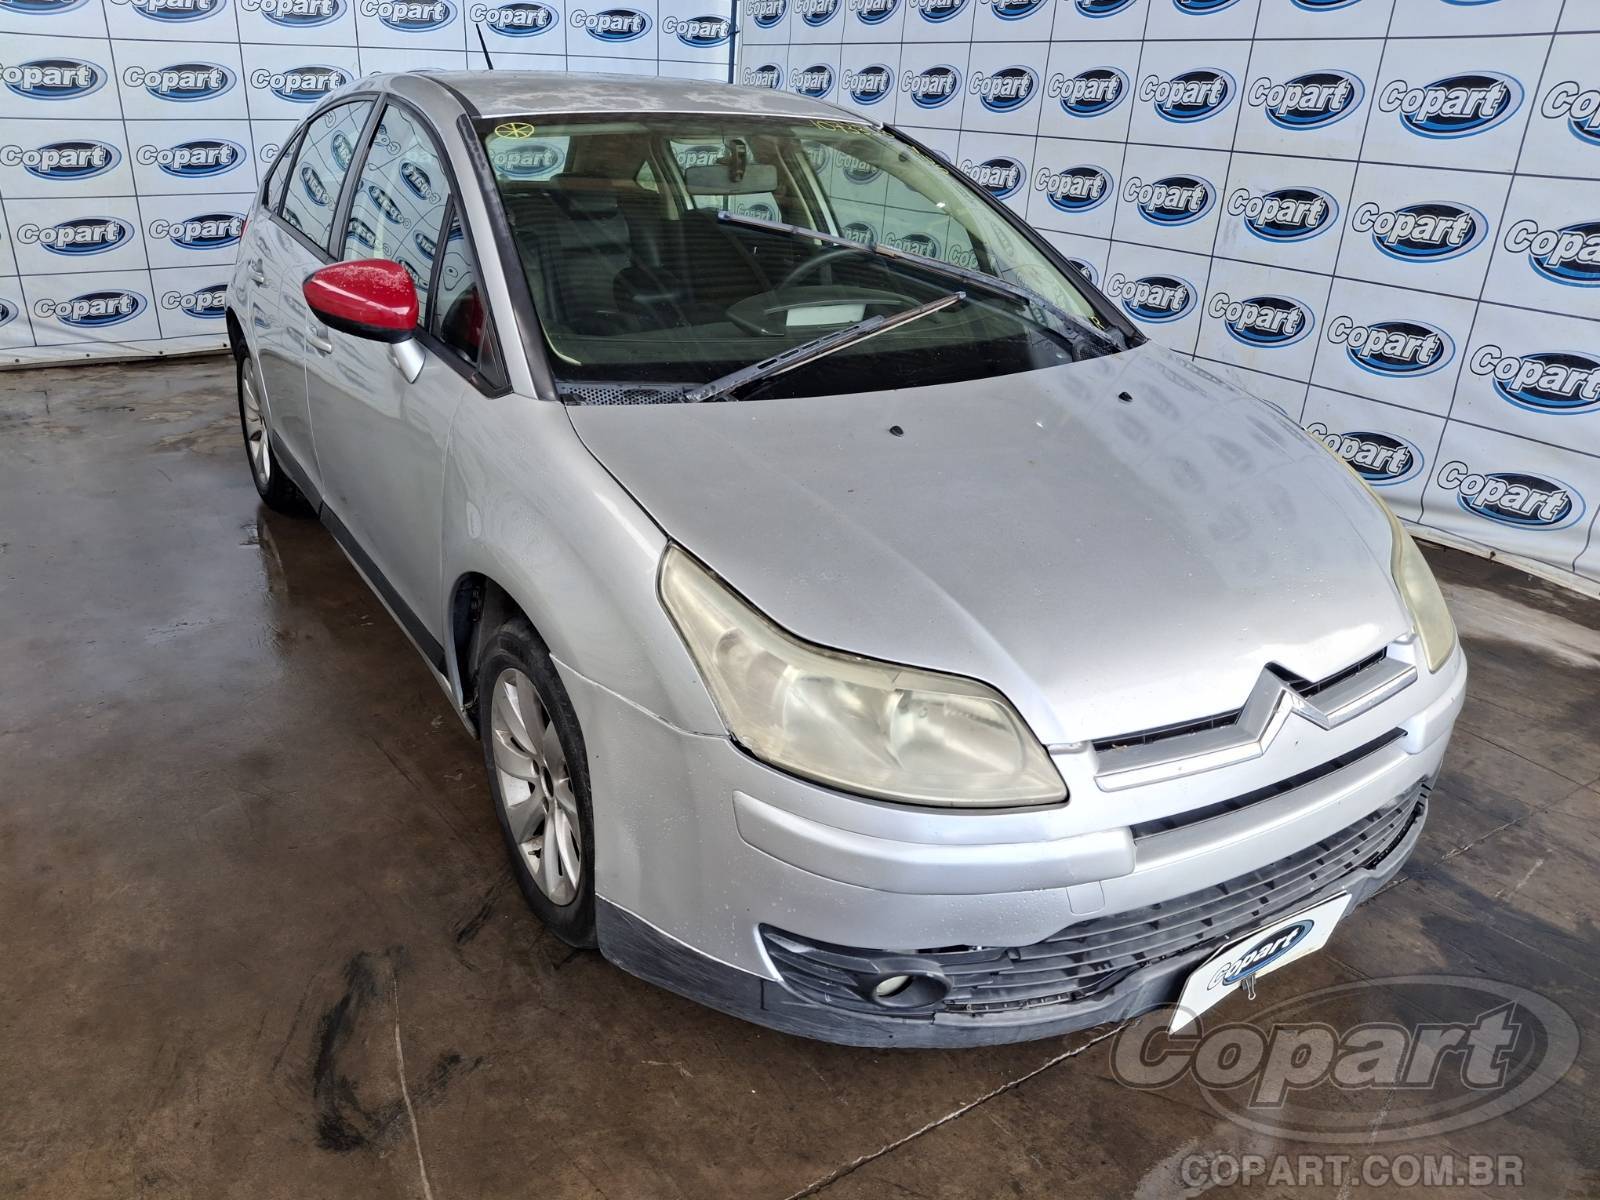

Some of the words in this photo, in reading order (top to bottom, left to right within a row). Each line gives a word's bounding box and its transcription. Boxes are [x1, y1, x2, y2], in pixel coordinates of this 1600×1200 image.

[360, 0, 445, 21] Copart
[470, 4, 549, 28] Copart
[570, 9, 644, 33] Copart
[745, 0, 784, 17] Copart
[662, 16, 730, 39] Copart
[0, 65, 91, 90] opart
[123, 66, 223, 92] Copart
[250, 68, 341, 93] Copart
[743, 67, 779, 88] Copart
[789, 68, 832, 94] Copart
[841, 69, 889, 96] Copart
[900, 70, 956, 98] Copart
[969, 71, 1031, 102] Copart
[1048, 72, 1121, 107] Copart
[1139, 74, 1226, 111] Copart
[1248, 77, 1353, 117] Copart
[1379, 80, 1507, 122] Copart
[0, 144, 107, 172] Copart
[136, 144, 233, 170] Copart
[960, 159, 1020, 188] Copart
[1035, 168, 1105, 199] Copart
[1123, 176, 1207, 212] Copart
[1227, 188, 1327, 229] Copart
[17, 221, 120, 249] Copart
[149, 217, 242, 242] Copart
[1352, 202, 1472, 246] Copart
[1106, 273, 1191, 312] Copart
[34, 294, 134, 321] Copart
[1208, 292, 1304, 335] Copart
[1327, 315, 1441, 364] Copart
[1470, 344, 1600, 400] Copart
[1437, 460, 1569, 521] Copart
[1207, 927, 1300, 991] Copart
